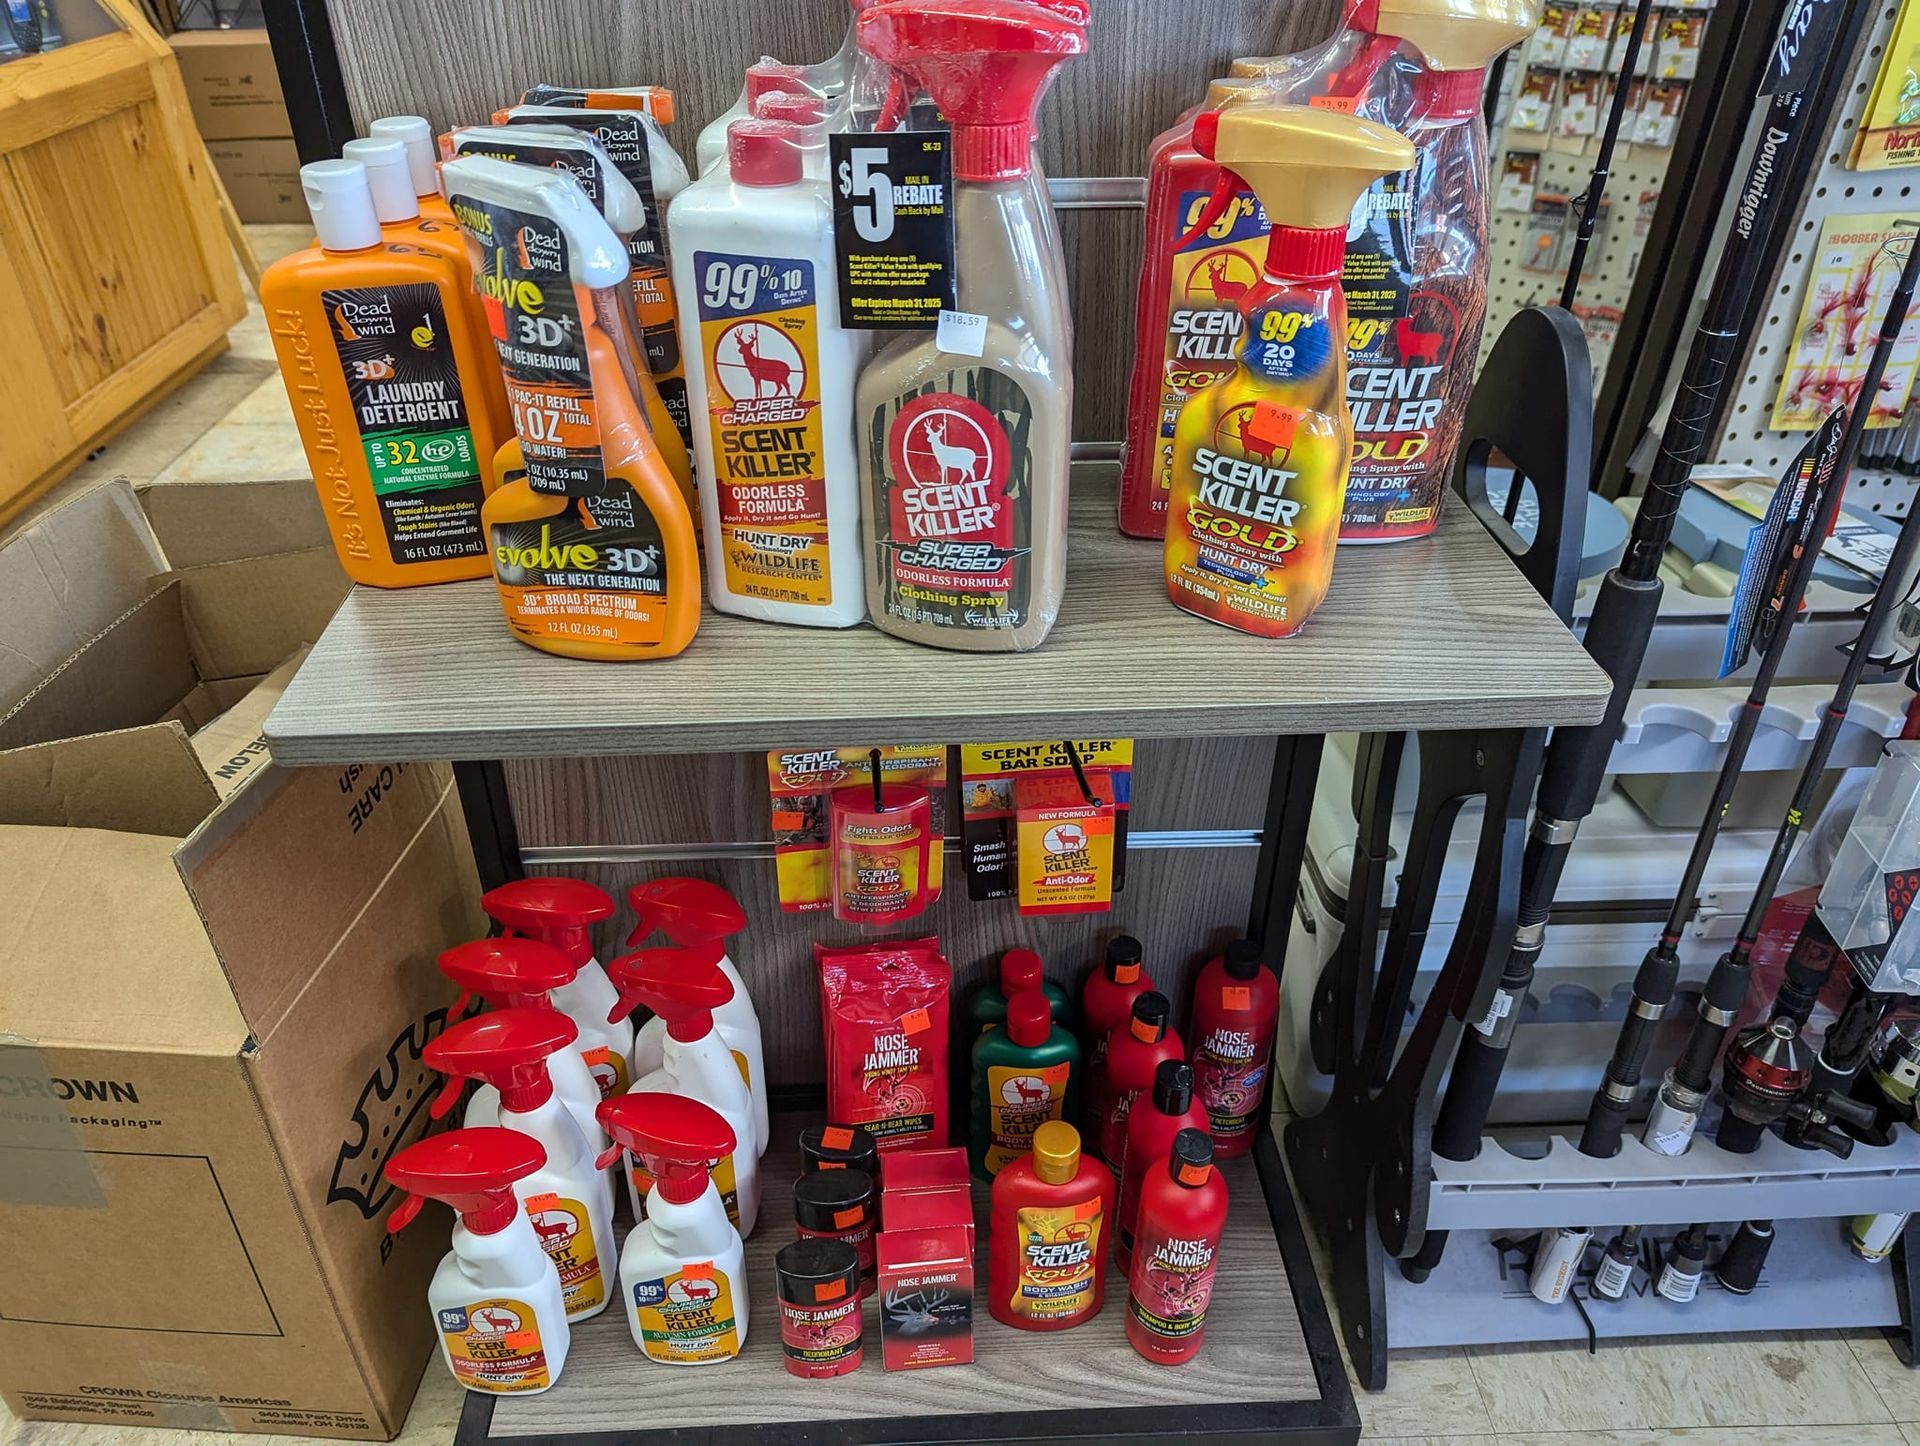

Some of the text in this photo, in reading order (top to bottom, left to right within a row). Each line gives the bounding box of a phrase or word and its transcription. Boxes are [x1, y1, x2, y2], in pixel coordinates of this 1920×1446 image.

[599, 121, 639, 141] Dead
[608, 143, 640, 161] wind
[1886, 151, 1915, 159] FISHING
[1736, 127, 1789, 240] Downrigger
[893, 185, 944, 205] REBATE
[1368, 193, 1410, 210] REBATE
[454, 203, 493, 231] BONUS
[523, 226, 561, 249] Dead
[1830, 233, 1878, 245] BOBBER
[531, 253, 563, 272] wind
[704, 261, 801, 311] 99% 10
[342, 295, 391, 317] Dead
[924, 298, 942, 307] 2025
[349, 315, 391, 325] down
[357, 318, 395, 336] wind
[945, 314, 979, 326] $18.59
[1169, 310, 1242, 335] SCEN
[1260, 310, 1314, 343] 99%
[518, 313, 575, 348] 3D+
[515, 348, 580, 372] GENERATION
[1264, 343, 1295, 360] 20
[352, 354, 396, 381] 3D+
[1263, 358, 1293, 368] DAYS
[366, 380, 445, 405] LAUNDRY
[515, 389, 582, 412] PAC-IT REFILL
[362, 398, 460, 427] DETERGENT
[734, 399, 793, 413] SUPER
[721, 409, 807, 425] CHARGED
[1271, 409, 1293, 423] 9.99
[527, 408, 592, 443] OZ TOTAL
[723, 426, 807, 454] SCENT
[386, 441, 420, 465] 32
[456, 435, 471, 463] LOADS
[532, 443, 567, 459] WATER!
[401, 464, 449, 476] CONCENTRATED
[727, 452, 812, 478] KILLER
[1192, 448, 1298, 496] SCENT
[1370, 461, 1424, 475] Spray with
[383, 470, 470, 485] NATURAL ENZYME FORMULA
[571, 469, 588, 482] mL)
[733, 483, 805, 499] ODORLESS
[903, 479, 991, 512] SCENT
[1786, 478, 1809, 521] NASCAR
[385, 499, 426, 509] Eliminates:
[587, 489, 633, 511] Dead
[739, 496, 806, 513] FORMULA
[1198, 477, 1300, 527] KILLER
[393, 501, 475, 517] Chemical Organic Odors
[397, 523, 419, 533] Tough
[595, 511, 635, 529] wind
[906, 503, 996, 538] KILLER
[436, 526, 464, 538] Garment
[1186, 508, 1296, 554] GOLD
[443, 540, 484, 557] (473 mL)
[495, 523, 661, 574] evolve 3D+
[734, 530, 809, 550] HUNT DRY
[1192, 527, 1282, 563] Clothing Spray with
[918, 540, 990, 558] SUPER
[740, 550, 819, 572] WILDLIFE
[899, 551, 1006, 570] CHARGED
[1199, 546, 1268, 575] HUNT DRY
[544, 573, 660, 591] THE NEXT GENERATION
[897, 568, 1008, 588] ODORLESS FORMULA
[544, 592, 637, 610] BROAD SPECTRUM
[899, 586, 1004, 608] Clothing Spray
[1232, 593, 1288, 616] WILDLIFE
[517, 604, 650, 623] TERMINATES ODORS!
[781, 750, 836, 765] SCENT
[982, 744, 1043, 760] SCENT
[788, 759, 841, 775] KILLER
[1001, 758, 1038, 771] BAR
[348, 765, 393, 834] CARE
[1039, 811, 1097, 821] NEW FORMULA
[847, 822, 912, 835] Fights Odors
[974, 842, 1006, 853] Smash
[1043, 849, 1089, 863] SCENT
[973, 853, 1007, 863] Human
[1046, 859, 1090, 873] KILLER
[856, 869, 897, 877] SCENT
[977, 863, 1005, 874] Odor!
[861, 875, 900, 884] KILLER
[1046, 875, 1090, 886] Anti-Odor
[875, 1033, 910, 1053] NOSE
[1215, 1027, 1249, 1047] NOSE
[1204, 1035, 1255, 1059] JAMMER
[864, 1048, 919, 1070] JAMMER
[1027, 1240, 1087, 1257] SCENT
[1168, 1238, 1207, 1255] NOSE
[1032, 1249, 1091, 1266] KILLER
[1154, 1244, 1213, 1267] JAMMER
[897, 1274, 958, 1288] NOSE JAMMER
[1024, 1280, 1088, 1294] BODY WASH
[442, 1312, 466, 1324] 99%
[663, 1307, 712, 1323] SCENT
[785, 1302, 855, 1322] NOSE JAMMER
[666, 1317, 715, 1331] KILLER
[470, 1349, 519, 1360] KILLER
[803, 1347, 844, 1358] DEODORANT
[496, 1355, 537, 1368] FORMULA
[476, 1372, 503, 1381] HUNT
[79, 1385, 292, 1407] CROWN Americas
[103, 1407, 119, 1415] PA
[282, 1412, 304, 1420] Mill
[306, 1413, 332, 1421] Park
[335, 1415, 366, 1423] Drive
[313, 1420, 333, 1428] OH
